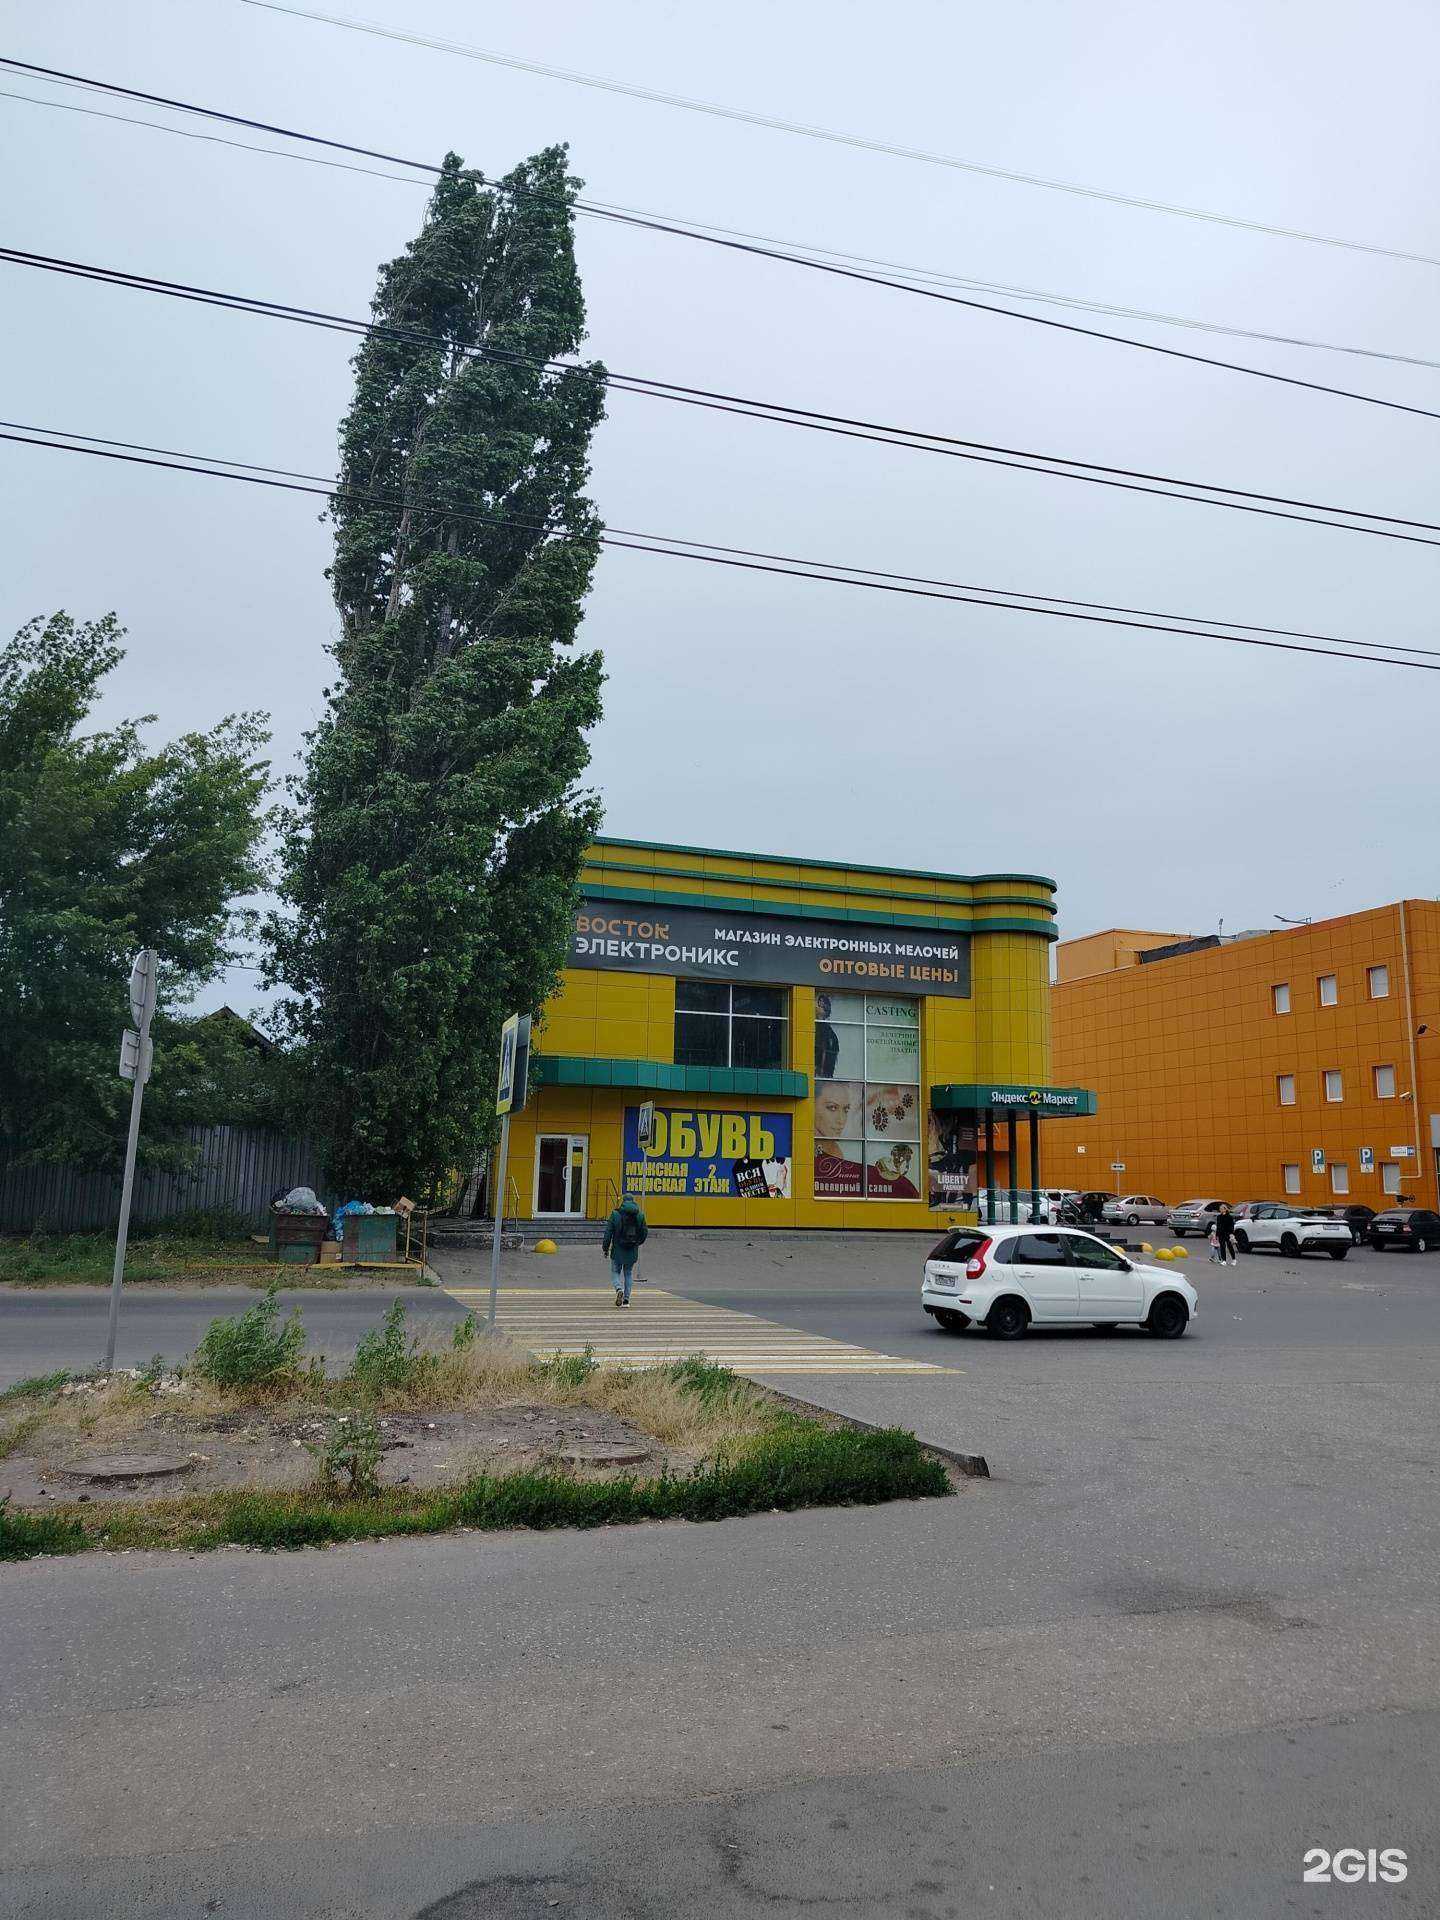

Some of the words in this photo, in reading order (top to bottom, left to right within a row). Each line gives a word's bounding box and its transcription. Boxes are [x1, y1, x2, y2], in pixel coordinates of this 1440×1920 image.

[576, 914, 670, 940] ВОСТОК
[575, 937, 739, 967] ЭЛЕКТРОНИКС
[714, 928, 781, 946] МАГАЗИН
[784, 934, 892, 955] ЭЛЕКТРОННЫХ
[895, 944, 959, 960] МЕЛОЧЕЙ
[819, 958, 905, 978] ОПТОВЫЕ
[909, 966, 959, 983] ЦЕНЫ
[866, 1005, 917, 1018] CASTING
[991, 1091, 1029, 1104] Яндекс
[1042, 1092, 1079, 1106] Маркет
[708, 1164, 717, 1179] 2
[736, 1167, 761, 1183] ВСЯ
[937, 1174, 969, 1185] LIBERTY
[694, 1177, 730, 1193] ЭТАЖ
